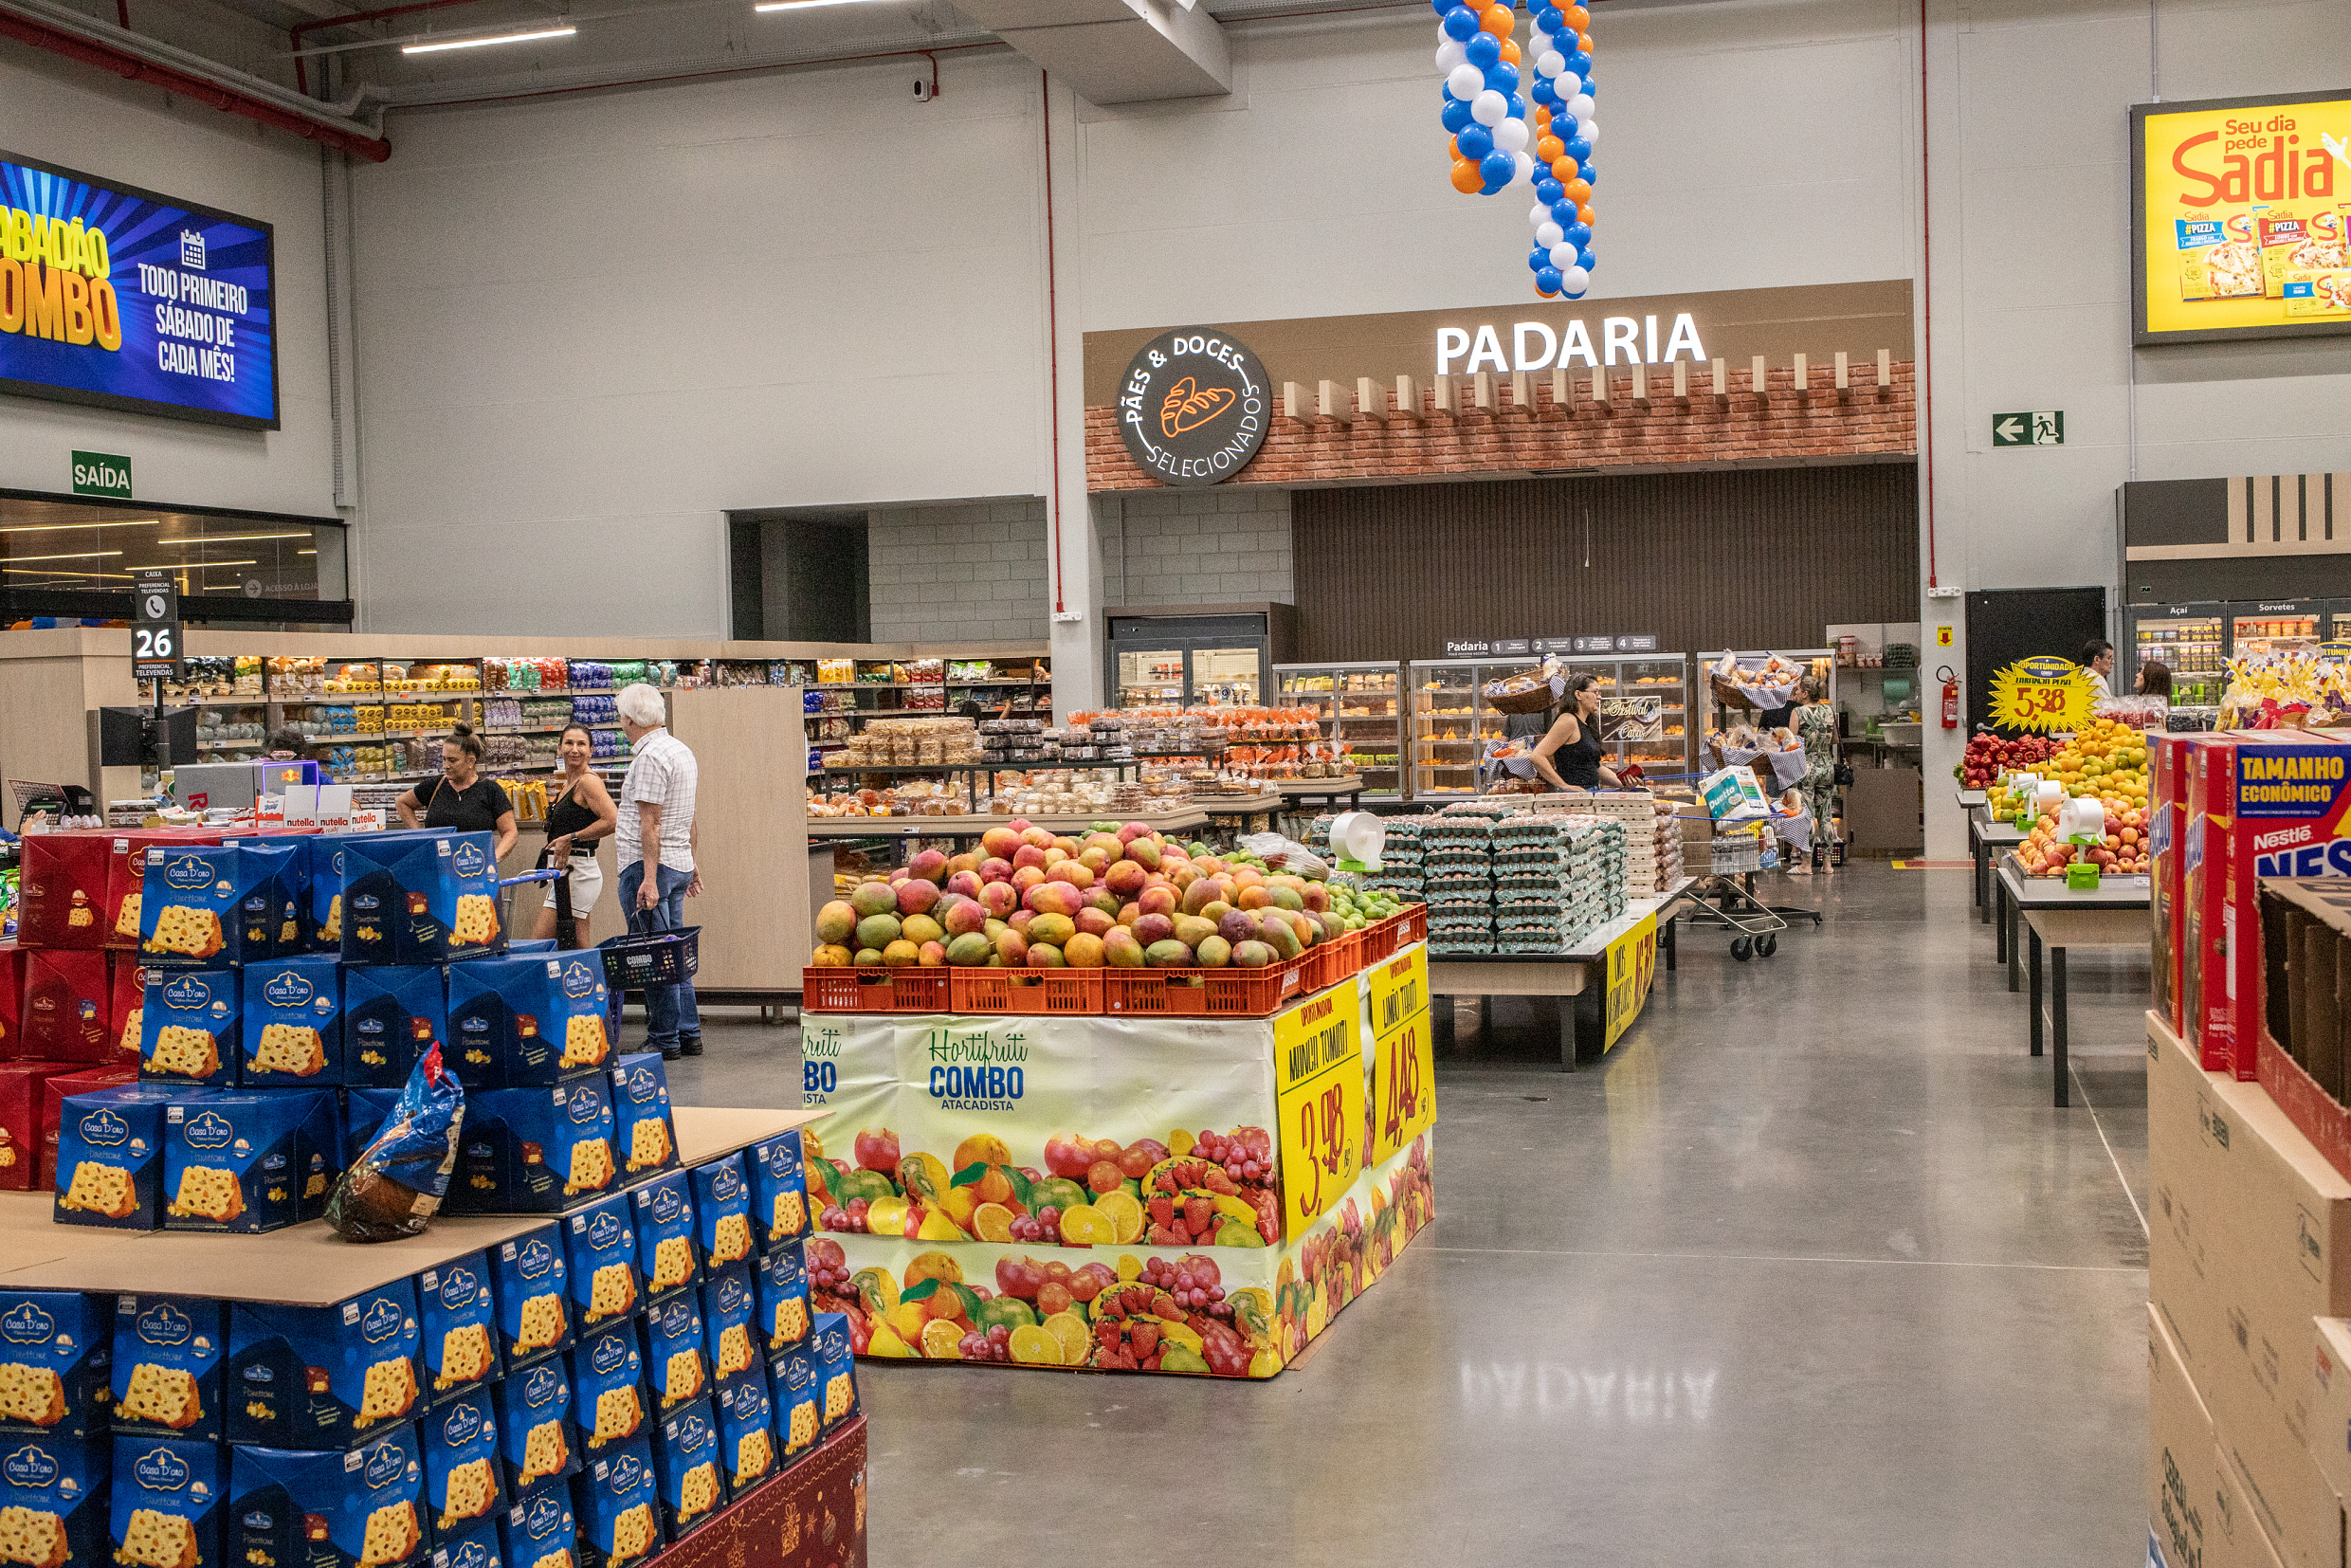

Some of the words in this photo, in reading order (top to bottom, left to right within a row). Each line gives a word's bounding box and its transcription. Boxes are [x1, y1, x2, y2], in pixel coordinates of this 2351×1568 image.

[2226, 119, 2262, 136] Seu
[2267, 115, 2296, 132] dia
[2226, 135, 2268, 154] pede
[2172, 130, 2334, 207] Sadia
[2184, 211, 2210, 221] Sadia
[2268, 210, 2293, 220] Sadia
[2185, 223, 2215, 235] #PIZZA
[2269, 221, 2300, 233] #PIZZA
[137, 263, 177, 301] TODO
[181, 272, 247, 315] PRIMEIRO
[155, 301, 213, 342] SÁBADO
[216, 319, 235, 347] DE
[1436, 312, 1706, 374] PADARIA
[158, 341, 197, 375] CADA
[200, 346, 235, 382] MÊS!
[1121, 369, 1151, 423] PÃES
[1148, 350, 1167, 368] &
[1174, 336, 1244, 371] DOCES
[1147, 385, 1262, 477] SELECIONADOS
[74, 464, 130, 489] SAÍDA
[2170, 606, 2188, 615] Açaí
[137, 629, 173, 657] 26
[1447, 641, 1488, 652] Padaria
[1536, 641, 1542, 649] 2
[1577, 640, 1584, 648] 3
[1619, 638, 1626, 647] 4
[2020, 662, 2074, 670] OPORTUNIDADE
[136, 668, 173, 677] TELEVENDAS
[1609, 701, 1648, 716] Festival
[2014, 687, 2066, 721] 5,38
[2241, 757, 2344, 780] TAMANHO
[2241, 781, 2331, 802] ECONÔMICO
[1709, 786, 1735, 810] Duetto
[287, 818, 315, 827] nutella
[320, 817, 348, 826] nutella
[352, 812, 376, 824] nutella
[2253, 825, 2311, 850] Nestlé
[457, 858, 469, 866] Casa
[189, 868, 210, 877] D'oro
[627, 954, 652, 965] COMBO
[168, 989, 185, 997] Casa
[929, 1066, 1024, 1100] COMBO
[1385, 1027, 1419, 1148] 4,48
[941, 1100, 1014, 1111] ATACADISTA
[84, 1122, 102, 1133] Casa
[103, 1123, 124, 1135] D'oro
[190, 1127, 207, 1137] Casa
[208, 1126, 228, 1136] D'oro
[1300, 1083, 1344, 1217] 3,98
[6, 1320, 26, 1329] Casa
[142, 1320, 162, 1330] Casa
[366, 1319, 382, 1331] Casa
[9, 1463, 28, 1473] Casa
[139, 1465, 159, 1476] Casa
[369, 1464, 385, 1476] Casa
